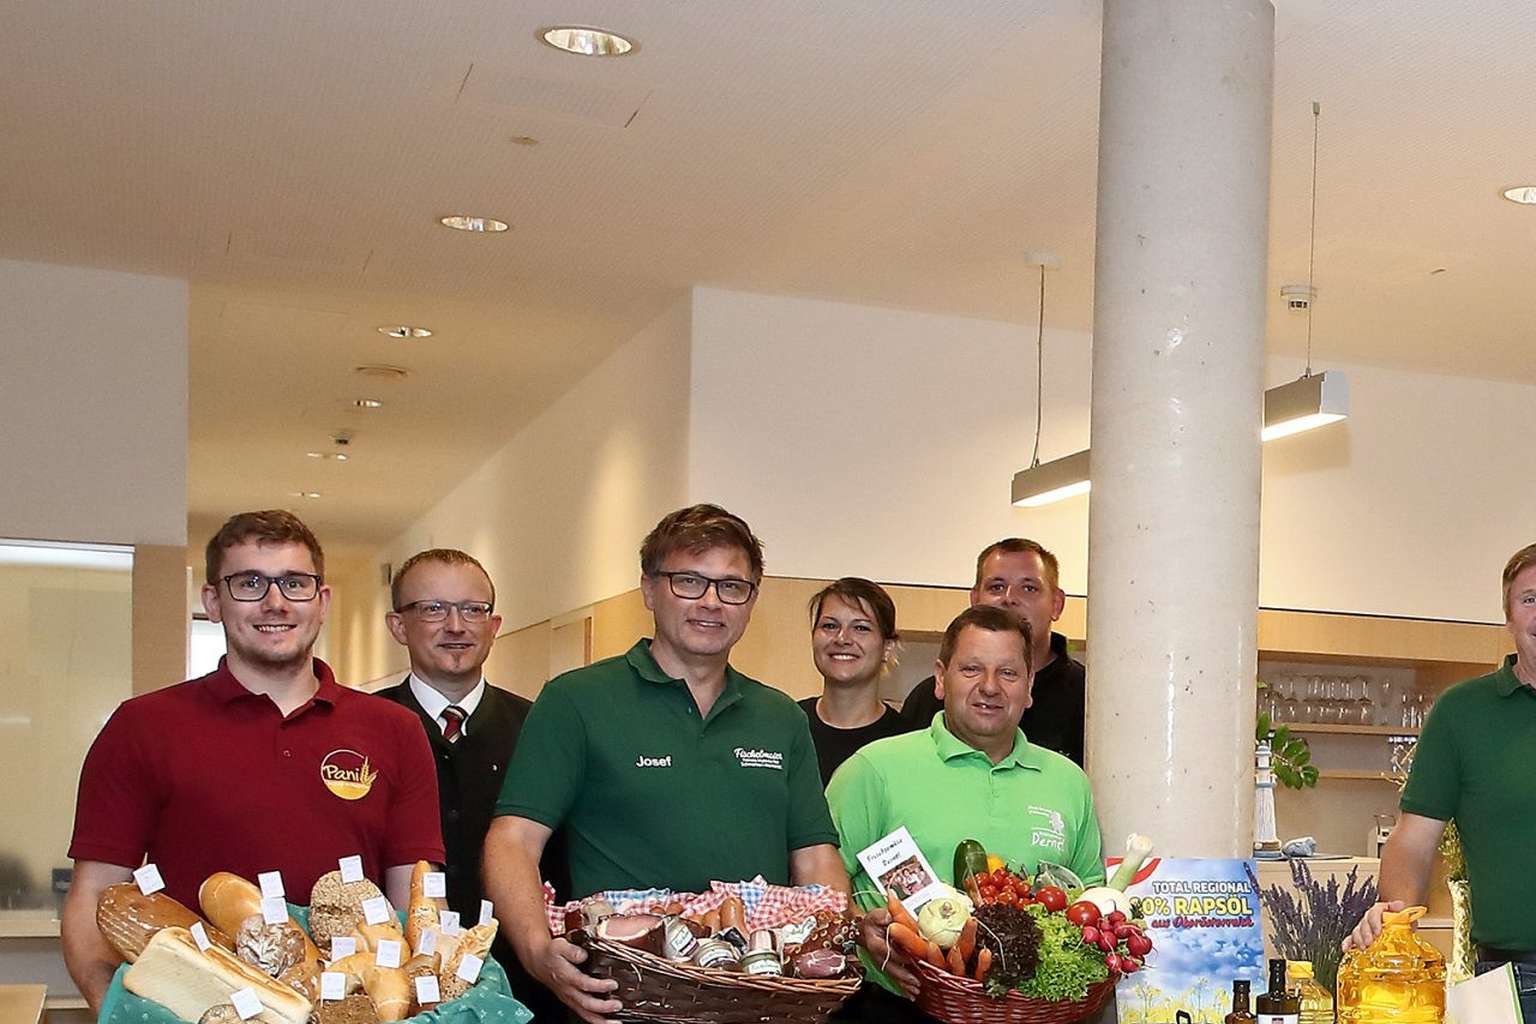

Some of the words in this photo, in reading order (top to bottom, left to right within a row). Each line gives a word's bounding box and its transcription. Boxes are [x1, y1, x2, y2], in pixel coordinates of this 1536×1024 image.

[636, 755, 672, 768] Josef
[323, 764, 360, 782] Pani
[1153, 881, 1191, 894] TOTAL
[1192, 881, 1251, 894] REGIONAL
[1174, 894, 1254, 916] RAPSÖL
